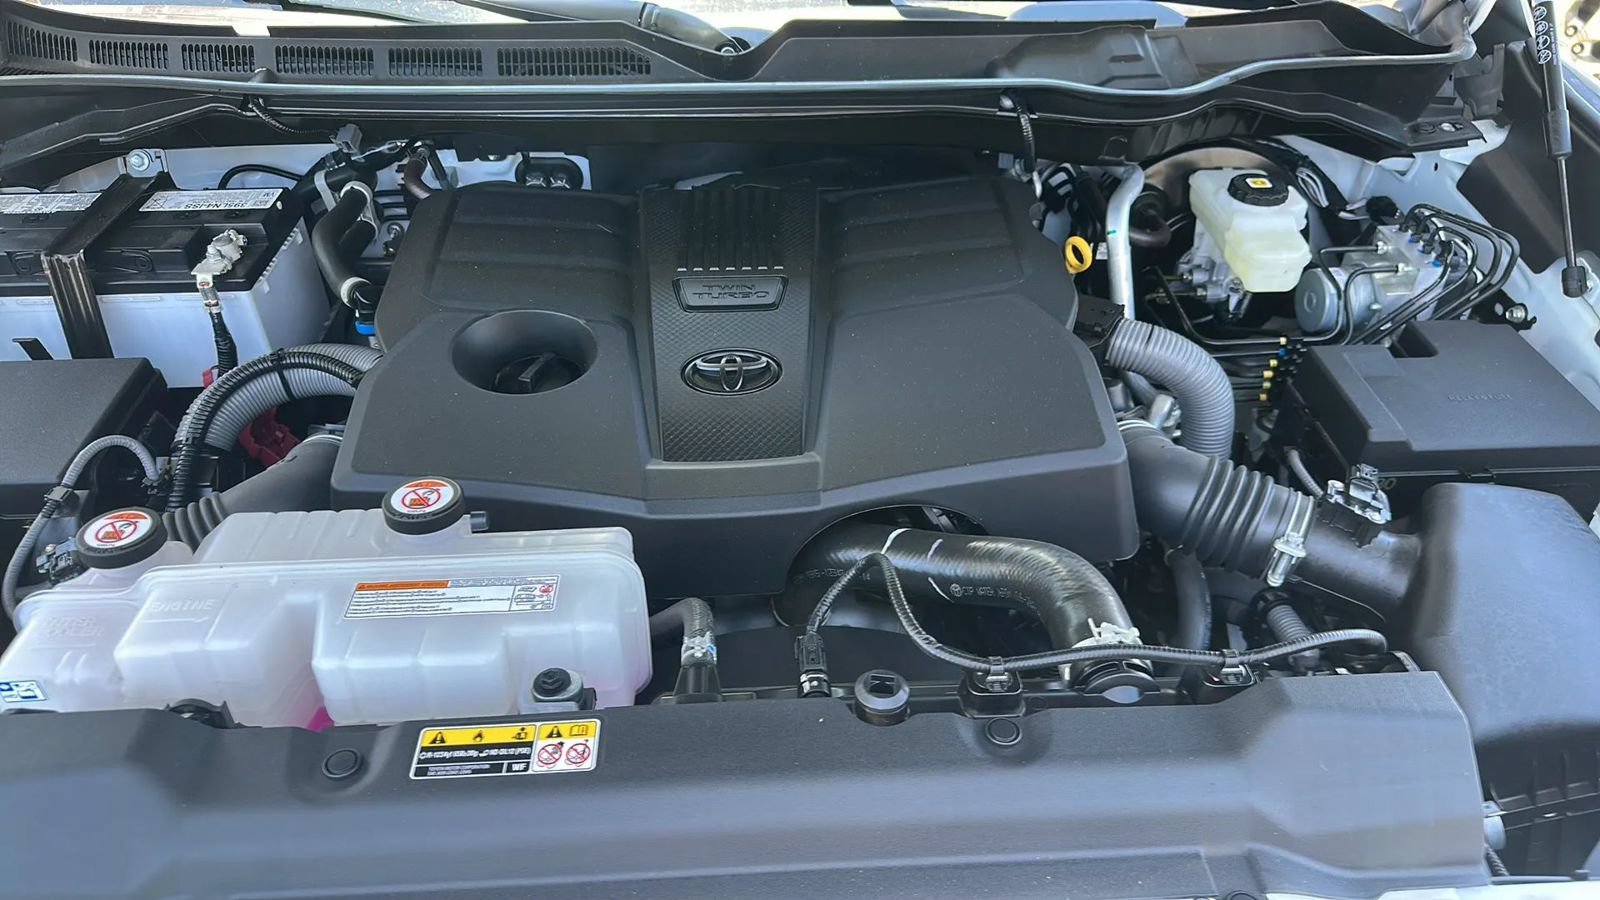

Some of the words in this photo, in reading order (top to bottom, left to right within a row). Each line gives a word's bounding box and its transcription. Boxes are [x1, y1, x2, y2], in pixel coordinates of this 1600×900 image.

[692, 290, 770, 299] TURBO
[150, 600, 215, 613] ENGINE
[511, 763, 527, 772] WF
